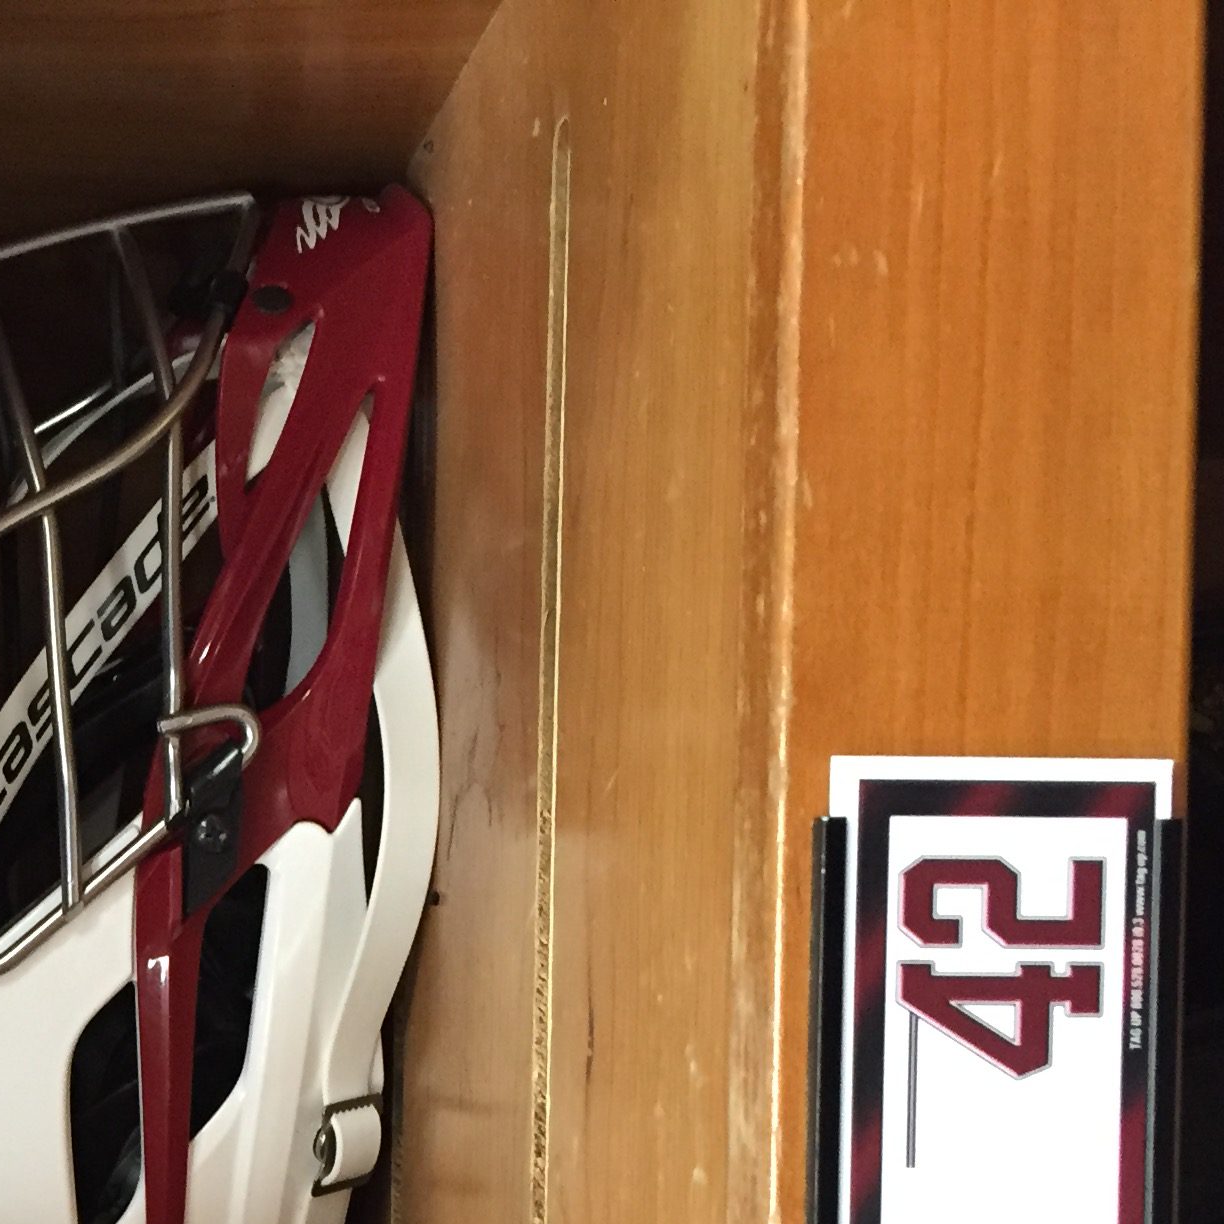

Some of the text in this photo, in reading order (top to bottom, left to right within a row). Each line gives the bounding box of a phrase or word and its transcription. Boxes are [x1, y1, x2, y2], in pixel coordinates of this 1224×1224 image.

[896, 855, 1106, 1079] 42
[1130, 1010, 1143, 1027] UP
[1129, 1028, 1142, 1050] TAG
